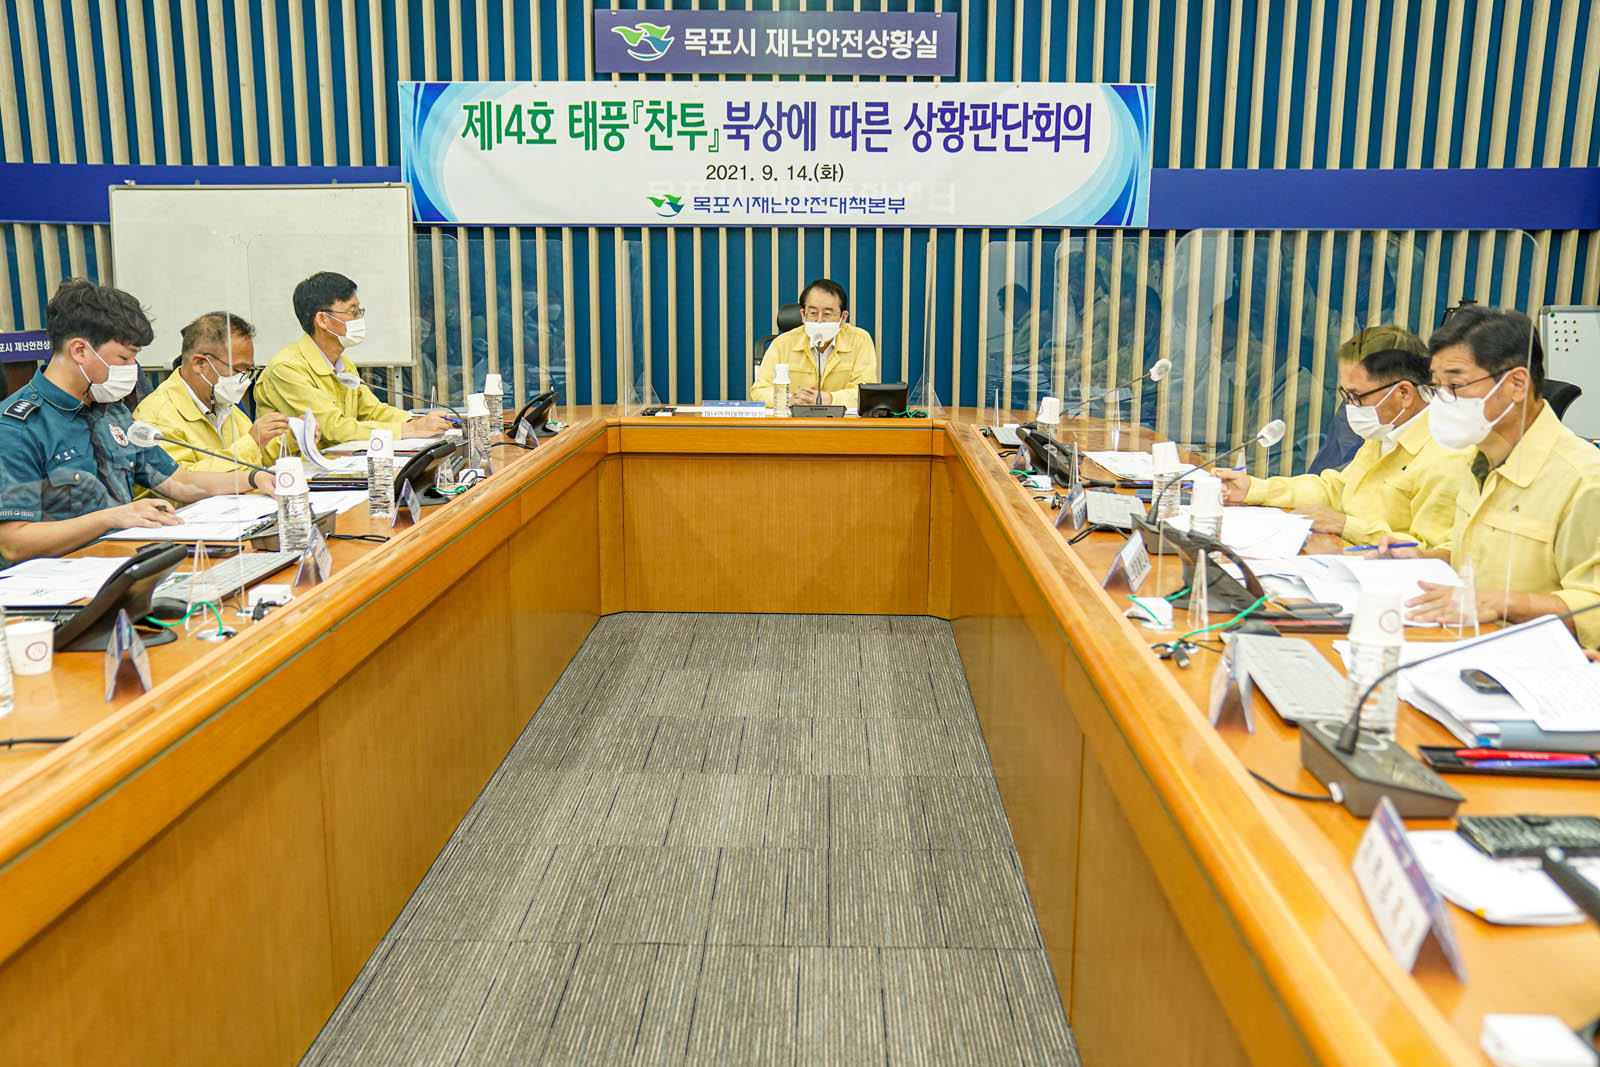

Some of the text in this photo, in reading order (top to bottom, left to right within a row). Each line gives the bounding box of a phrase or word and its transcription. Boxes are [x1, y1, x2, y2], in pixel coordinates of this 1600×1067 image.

[684, 28, 938, 60] 목포시 재난안전상황실
[461, 100, 557, 151] 제14호
[829, 101, 892, 152] 따른
[904, 100, 1093, 154] 상황판단회의
[706, 164, 844, 183] 2021. 9. 14.(화)
[693, 196, 906, 214] 목포시재난안전대책본부
